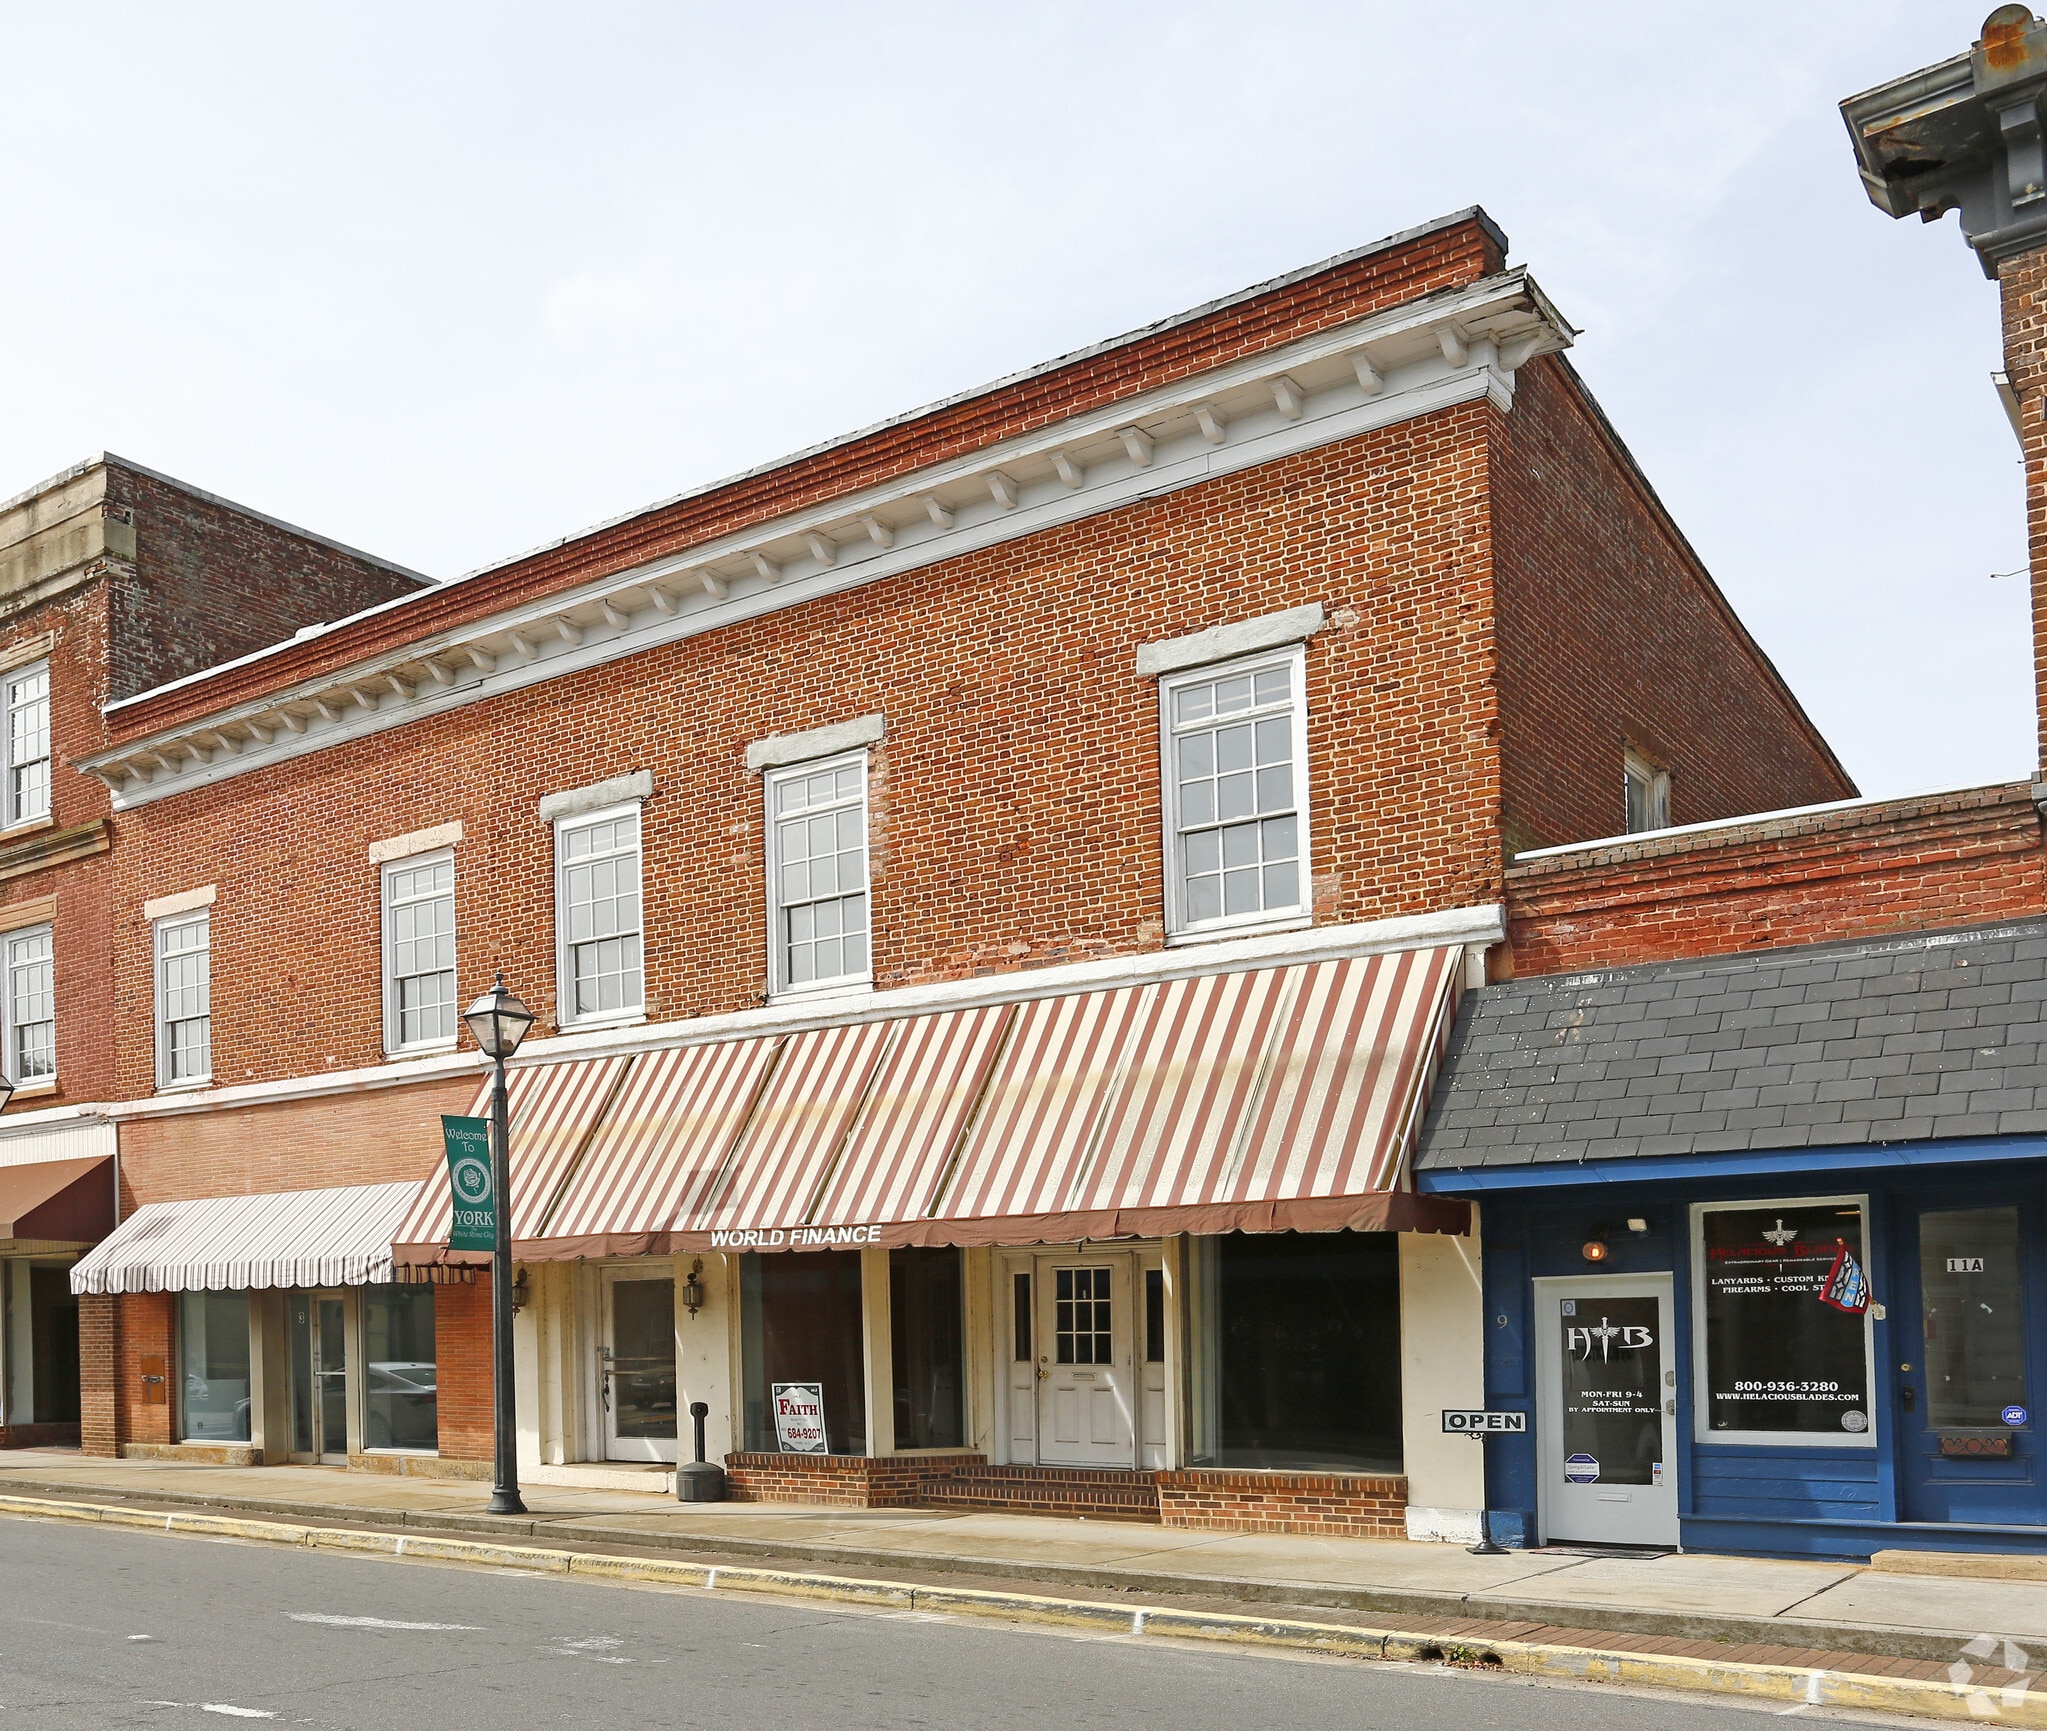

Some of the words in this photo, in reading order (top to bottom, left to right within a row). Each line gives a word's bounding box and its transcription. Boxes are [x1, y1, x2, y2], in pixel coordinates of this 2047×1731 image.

[445, 1128, 487, 1142] Welcome
[461, 1141, 475, 1153] To
[454, 1210, 494, 1226] YORK
[711, 1229, 785, 1247] WORLD
[789, 1225, 883, 1246] FINANCE
[1711, 1277, 1764, 1285] LANYARDS
[1774, 1275, 1814, 1283] CUSTOM
[1722, 1286, 1771, 1294] FIREARMS
[1497, 1314, 1508, 1329] 9
[1734, 1381, 1839, 1392] 800-936-3280
[1716, 1393, 1859, 1401] WWW.HELACIOUSBLADES.COM
[778, 1399, 818, 1415] FAITH
[2006, 1411, 2023, 1419] ADT
[1449, 1414, 1522, 1429] OPEN
[787, 1427, 821, 1439] 684-9207
